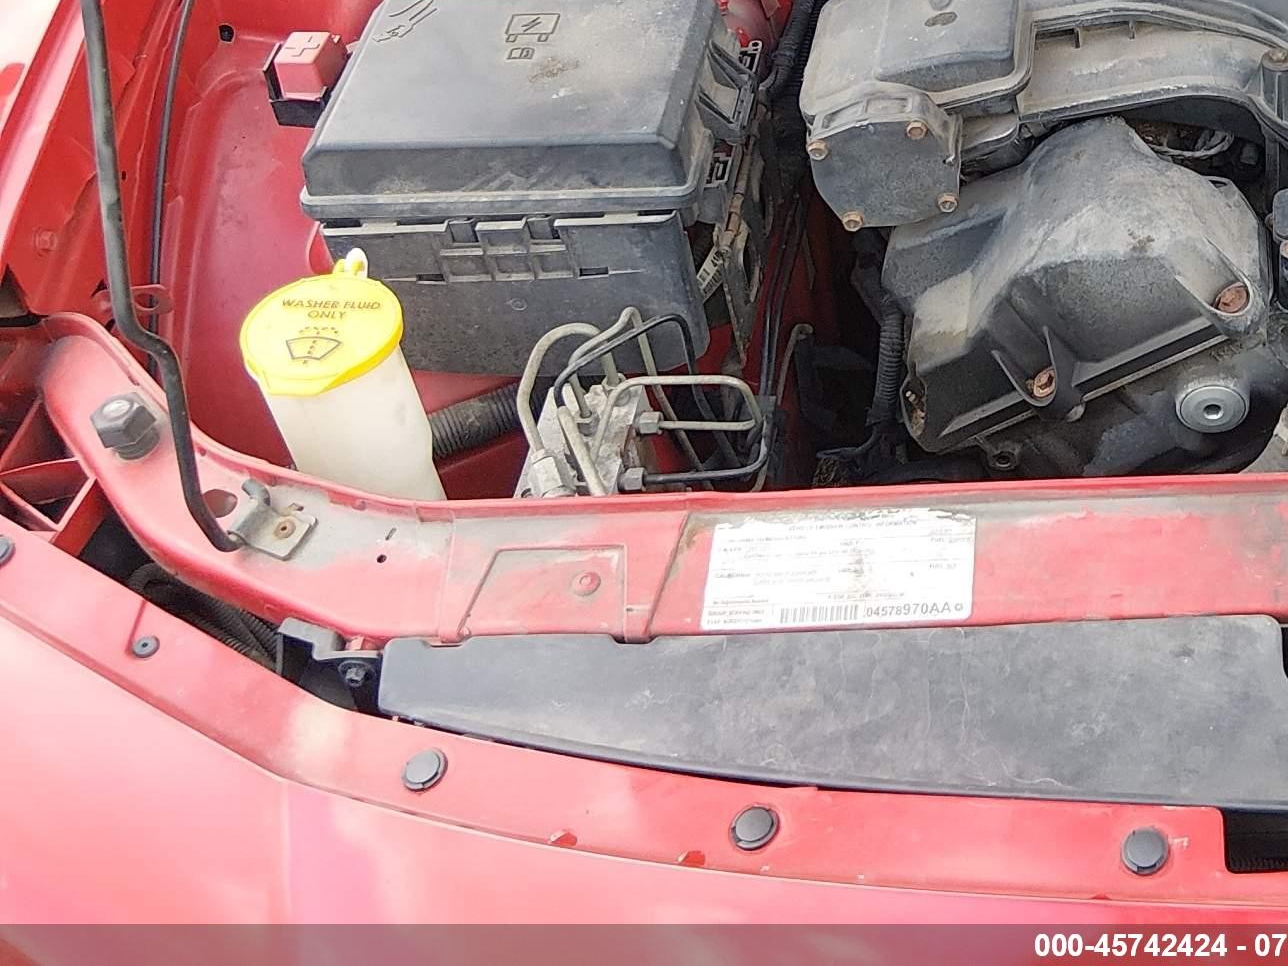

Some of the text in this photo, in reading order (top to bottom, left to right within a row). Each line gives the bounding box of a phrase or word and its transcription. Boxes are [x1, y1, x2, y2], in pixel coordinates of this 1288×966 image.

[282, 298, 381, 310] WASHER FLUID
[307, 310, 347, 320] ONLY
[866, 601, 952, 619] 04578970AA
